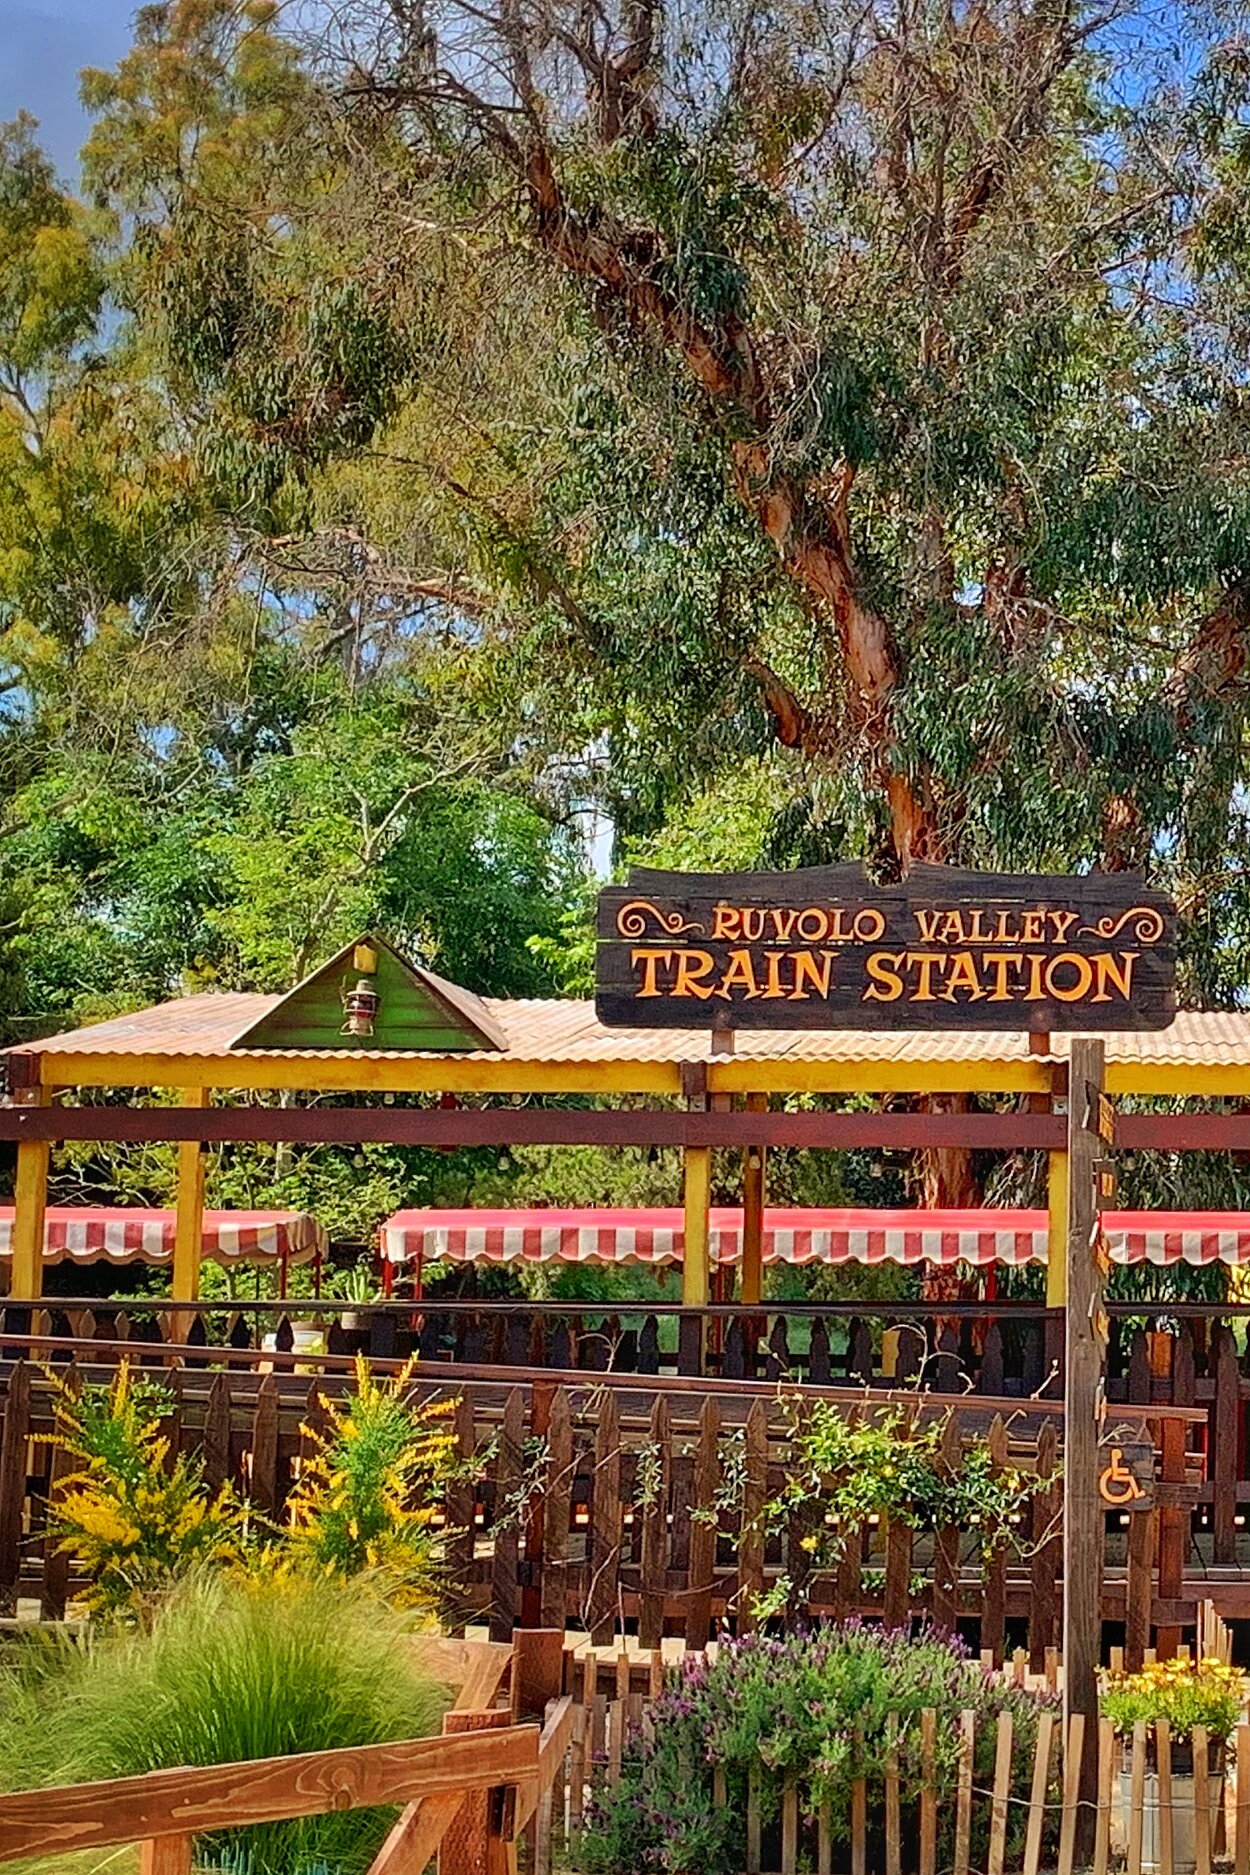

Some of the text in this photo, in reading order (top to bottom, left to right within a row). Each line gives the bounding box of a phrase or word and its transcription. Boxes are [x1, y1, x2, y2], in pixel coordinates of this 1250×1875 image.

[711, 906, 1080, 944] RUVOLO VALLEY
[631, 950, 1141, 1003] TRAIN STATION
